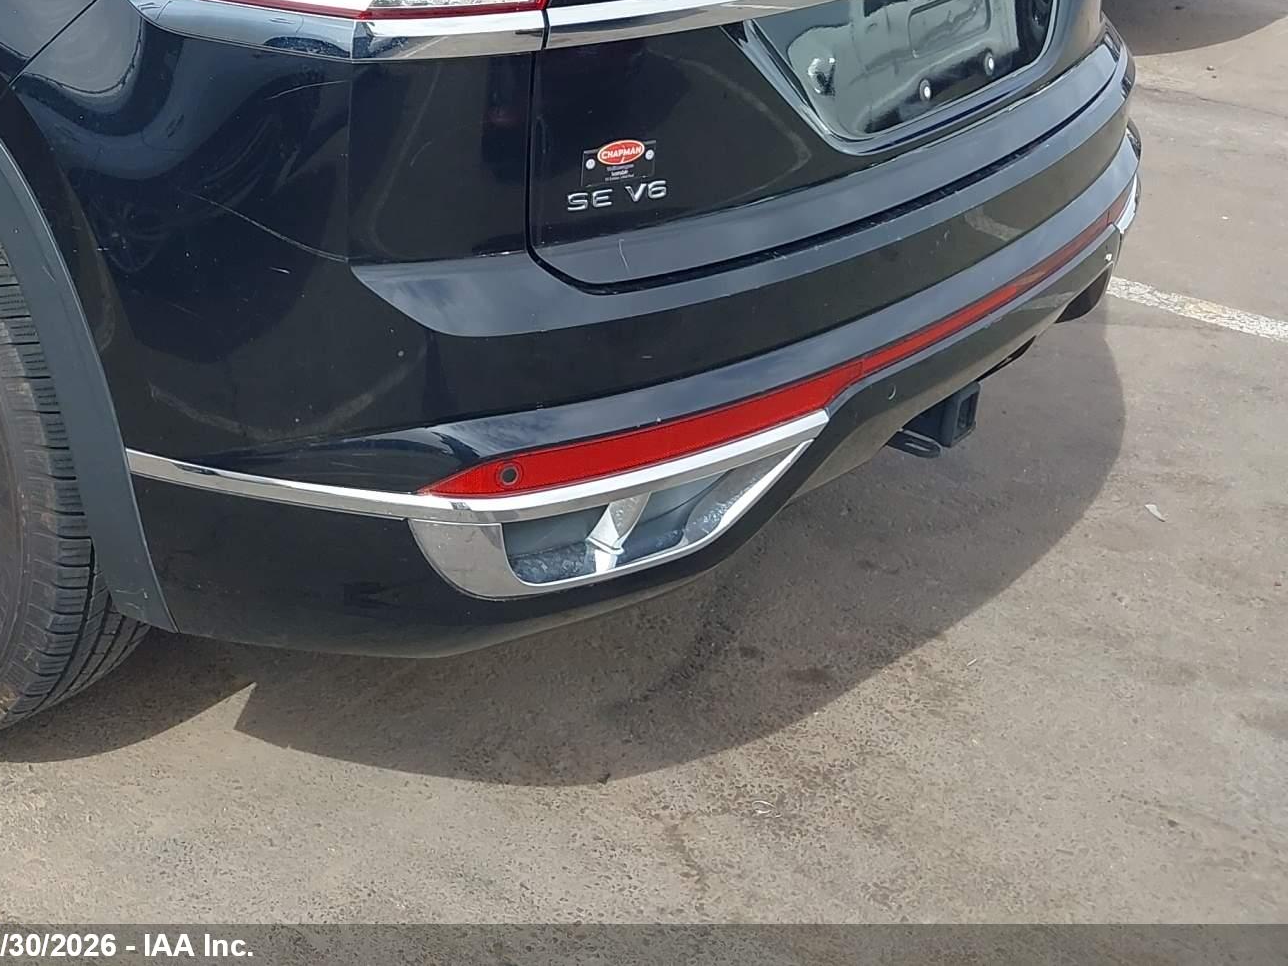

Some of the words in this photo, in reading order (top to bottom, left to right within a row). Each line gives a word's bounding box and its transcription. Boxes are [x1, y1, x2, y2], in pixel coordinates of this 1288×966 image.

[600, 145, 642, 160] CHAPMAN
[567, 188, 613, 211] SE
[625, 180, 667, 202] V6
